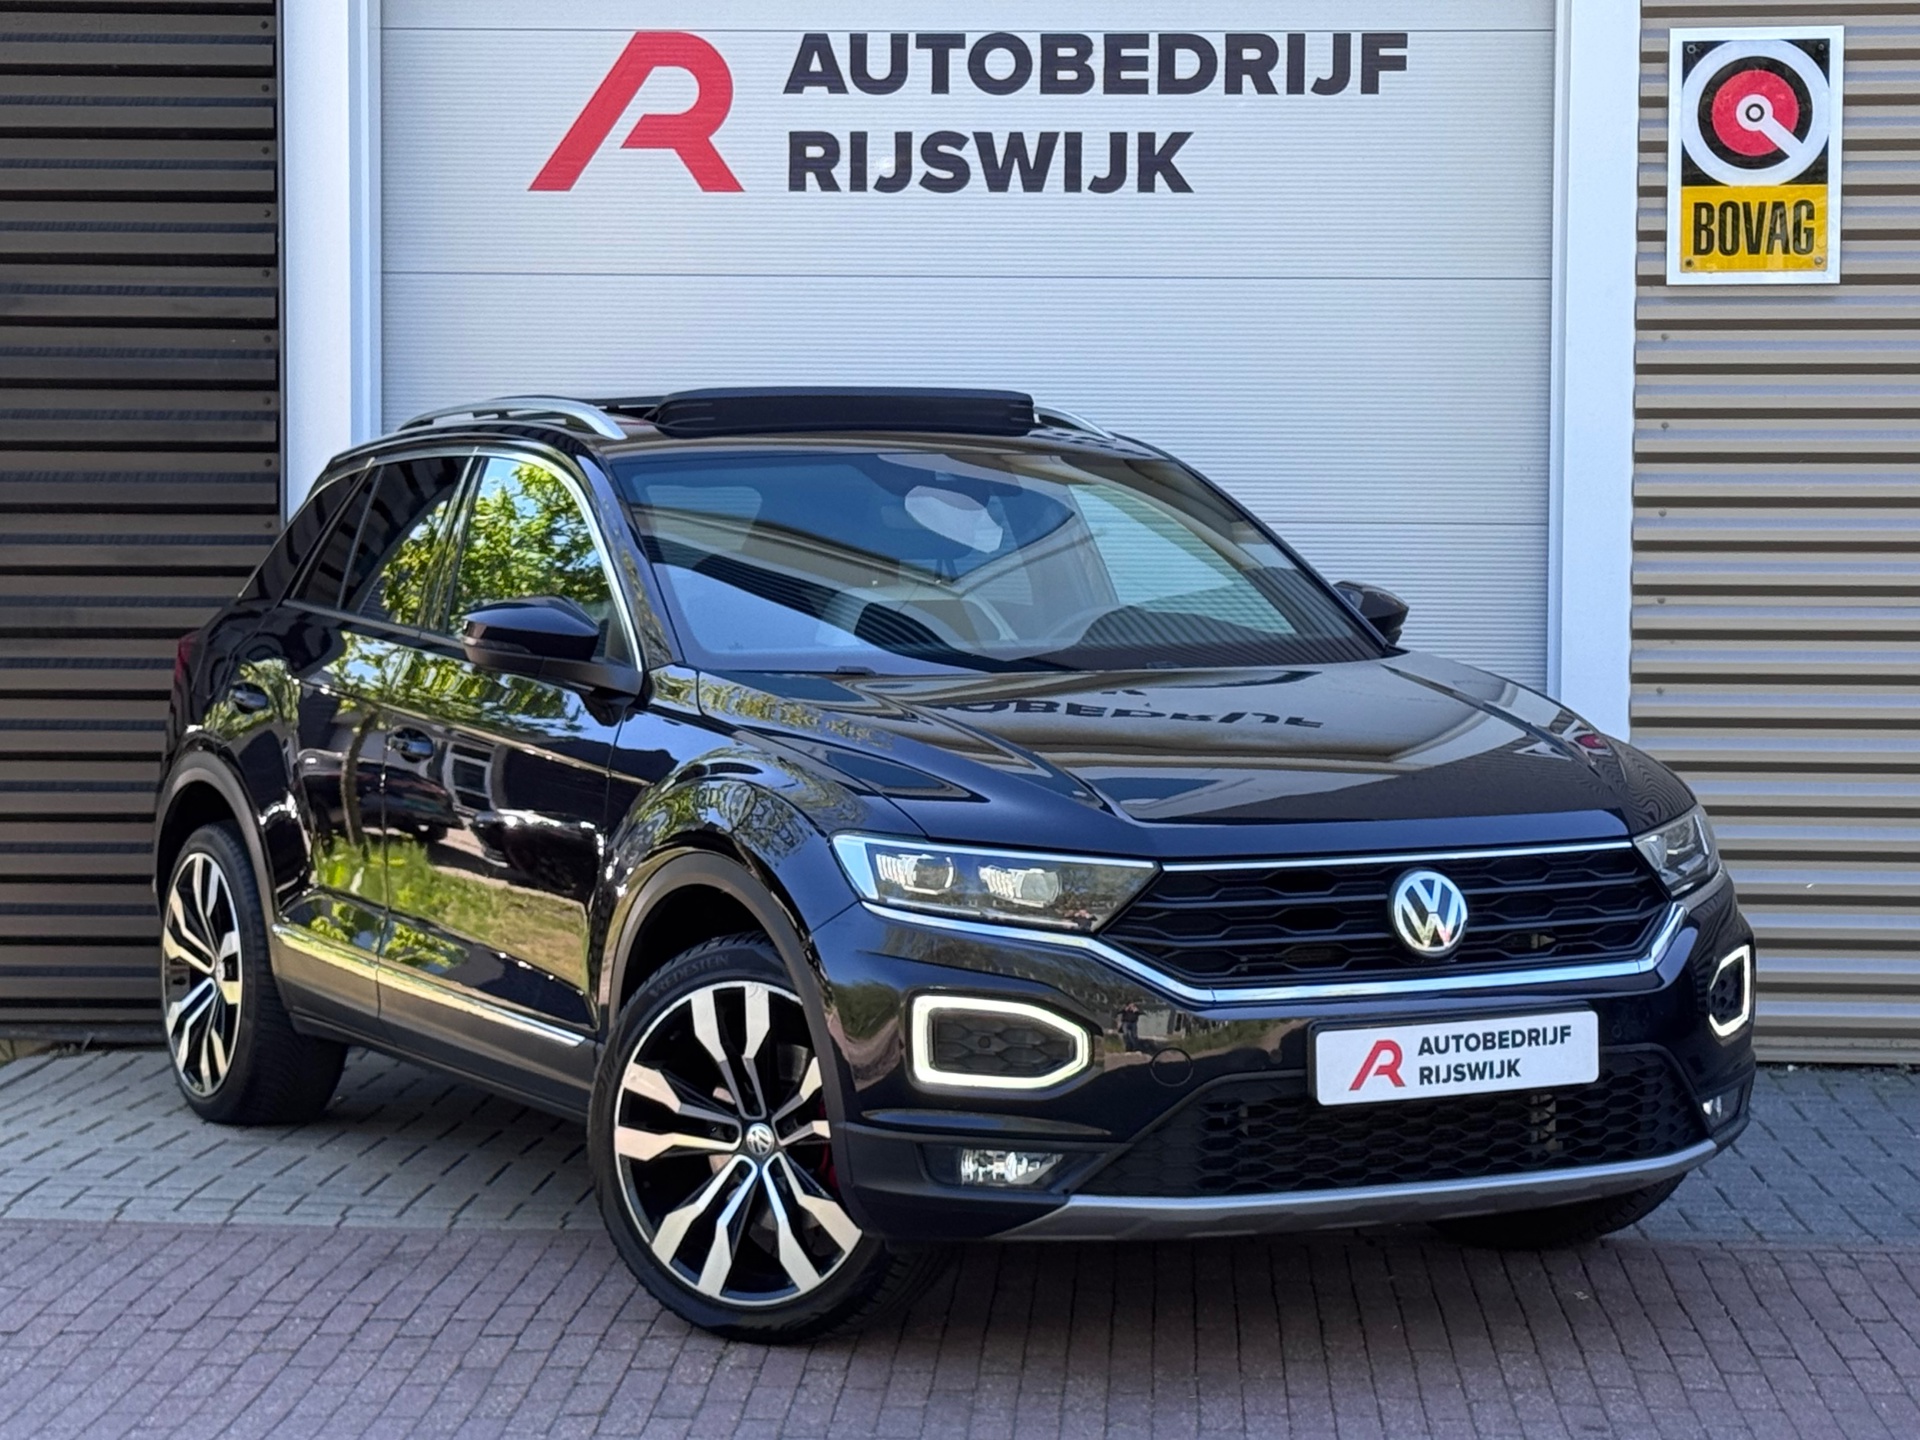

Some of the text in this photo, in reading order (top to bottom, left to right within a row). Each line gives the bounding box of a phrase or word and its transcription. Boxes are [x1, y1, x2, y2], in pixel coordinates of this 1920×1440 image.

[783, 32, 1408, 96] AUTOBEDRIJF
[788, 131, 1194, 193] RIJSWIJK
[1692, 199, 1815, 256] BOVAG
[1417, 1025, 1572, 1056] AUTOBEDRIJF
[1418, 1058, 1521, 1086] RIJSWIJK
